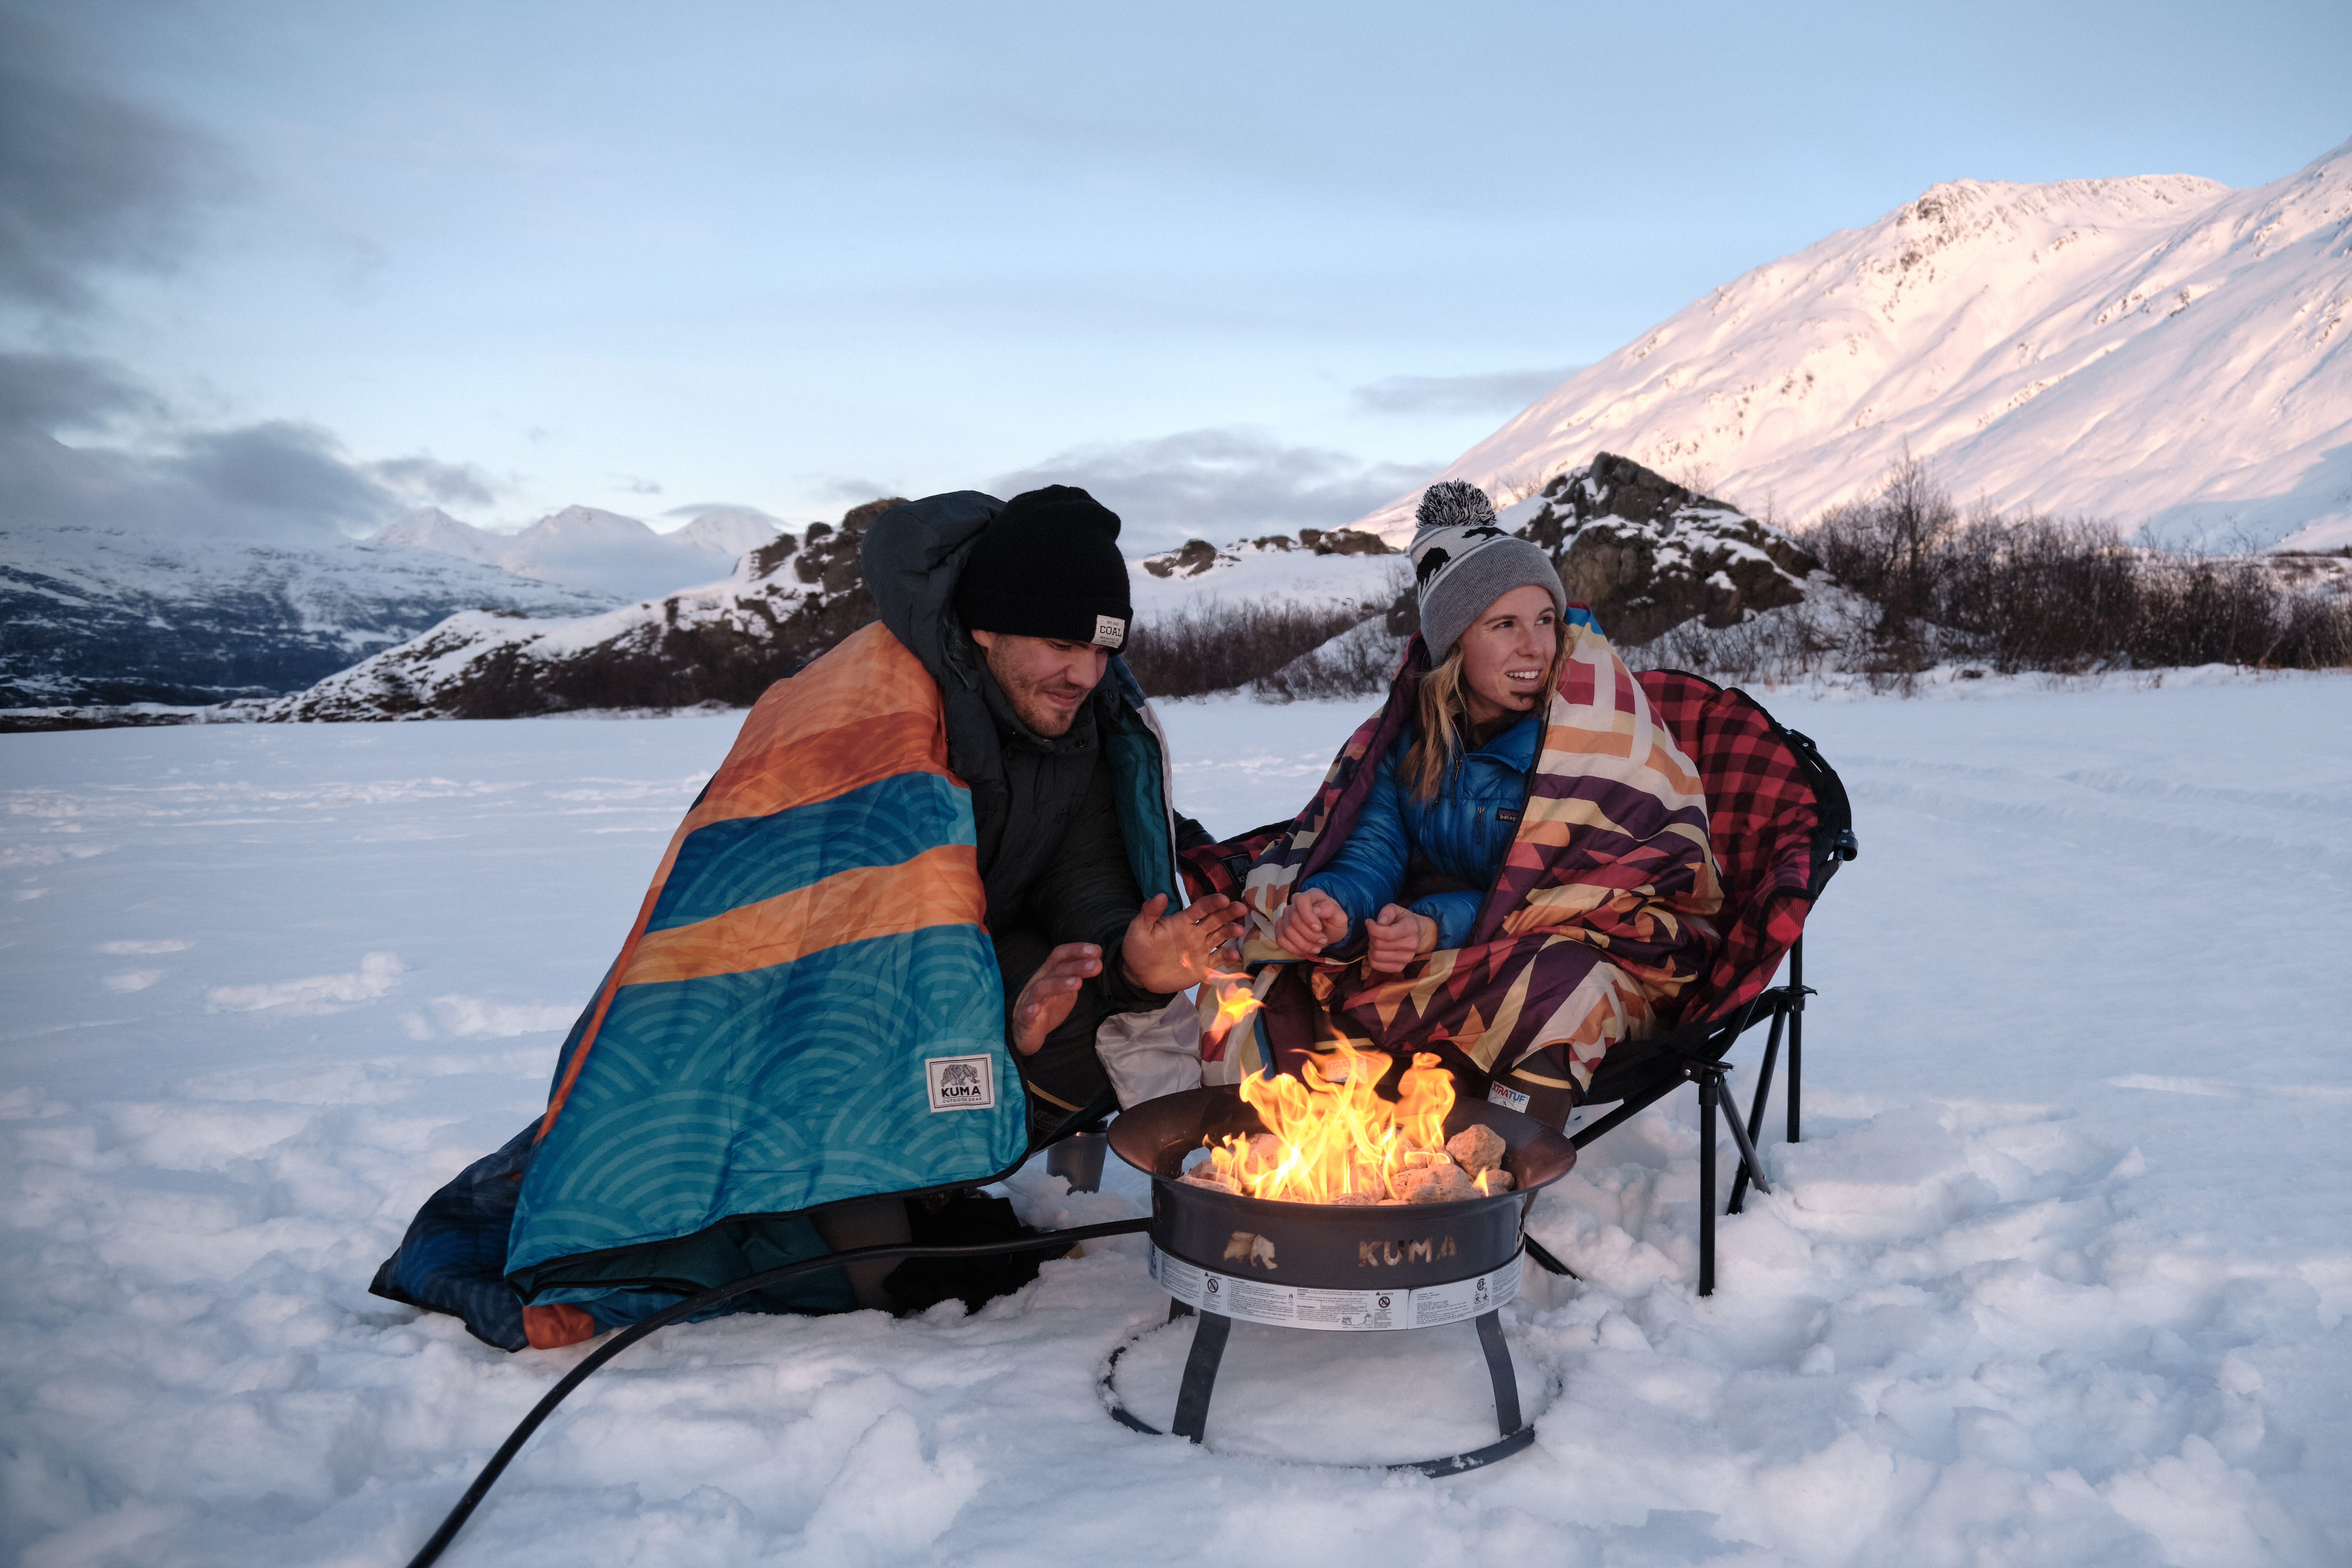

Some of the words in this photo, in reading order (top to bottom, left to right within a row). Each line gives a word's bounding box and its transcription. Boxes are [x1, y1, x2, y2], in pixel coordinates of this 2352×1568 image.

[1100, 625, 1122, 637] COAL
[941, 1086, 981, 1097] KUMA
[1492, 1083, 1526, 1103] XTRATUF
[1358, 1235, 1457, 1267] KUMA
